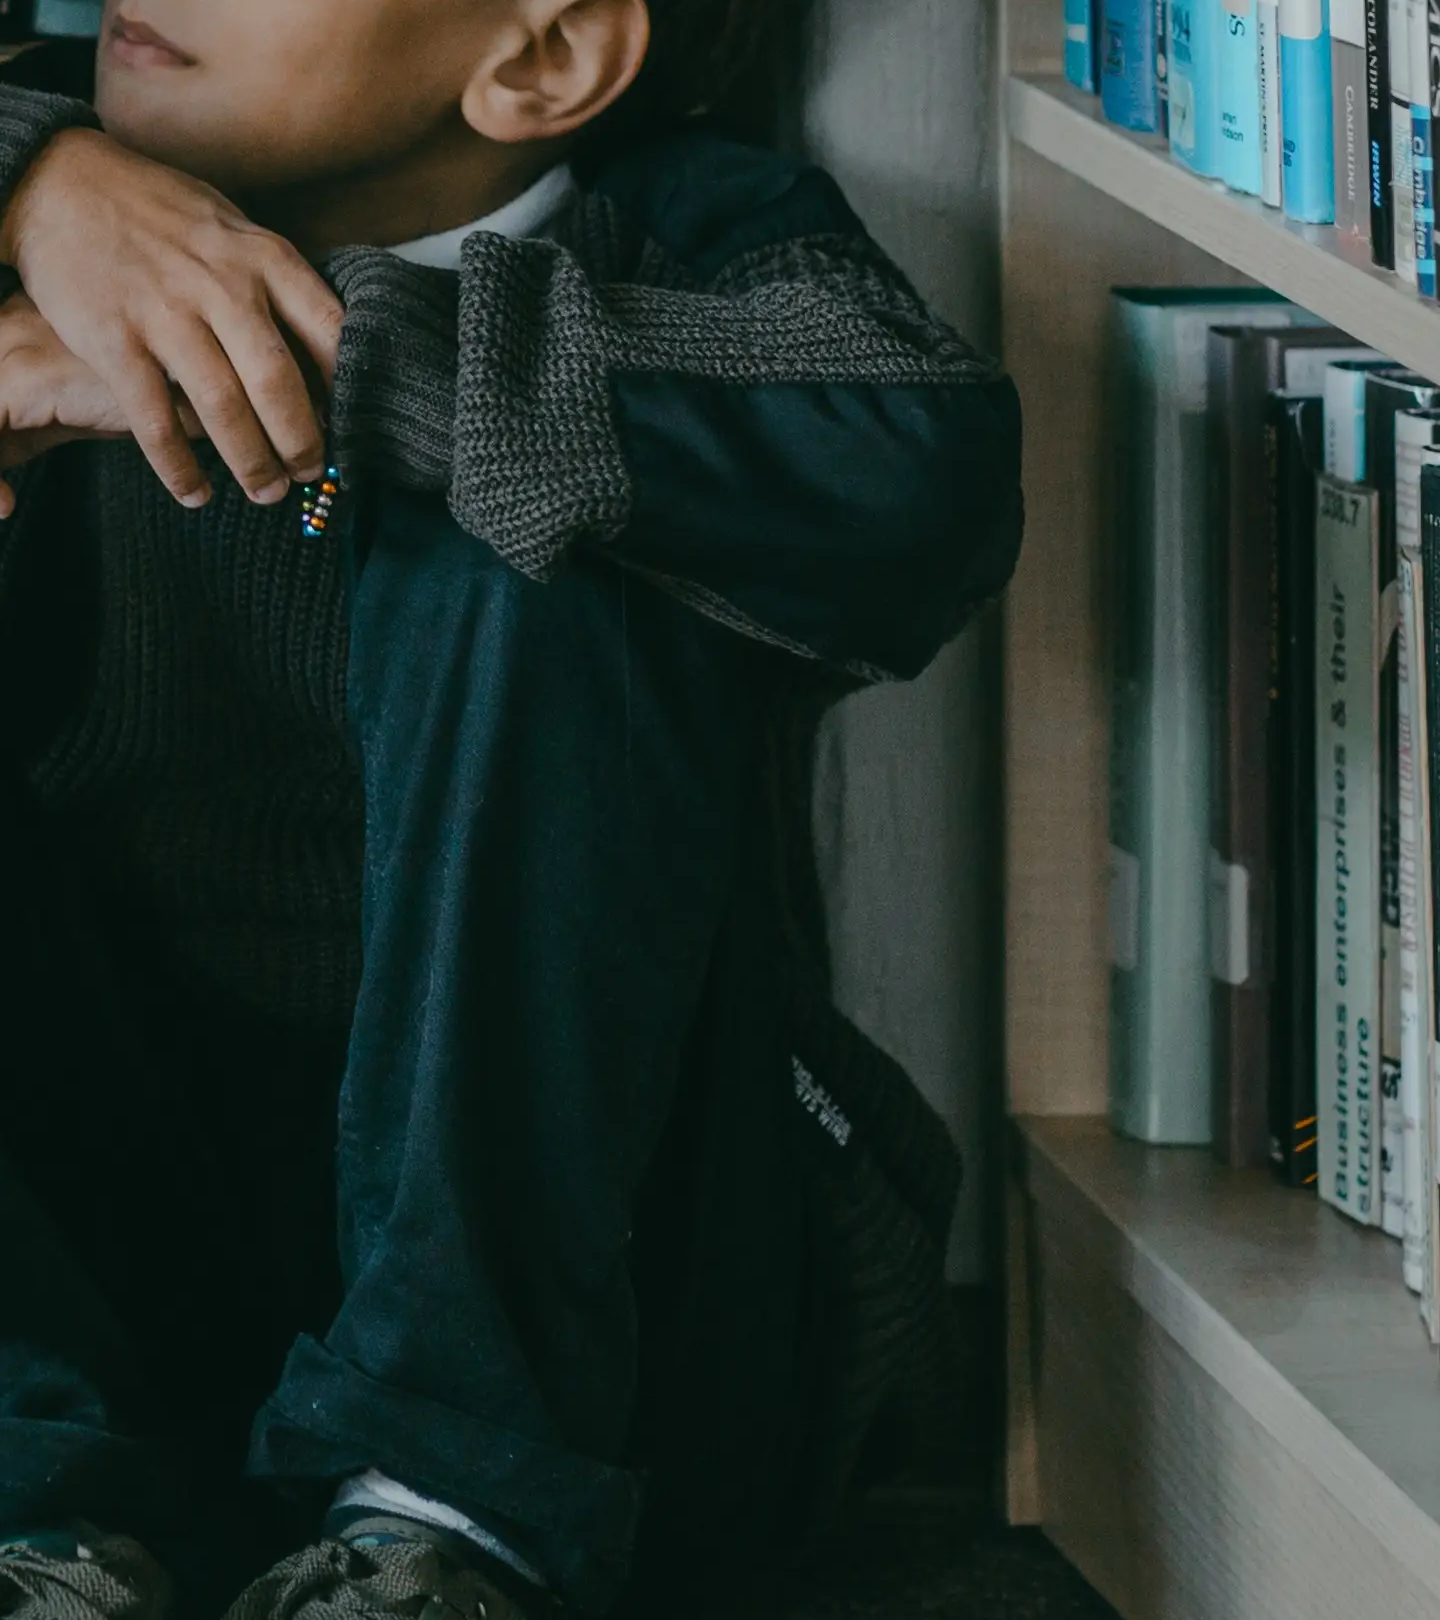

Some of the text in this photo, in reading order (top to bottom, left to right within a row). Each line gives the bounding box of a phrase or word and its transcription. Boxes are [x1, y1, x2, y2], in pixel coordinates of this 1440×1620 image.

[1344, 85, 1356, 202] CAMBRIDGE
[1371, 138, 1382, 208] IRWIN
[1412, 136, 1428, 262] Cambridge
[1331, 583, 1349, 1201] Business enterprises their
[1357, 1016, 1371, 1216] structure
